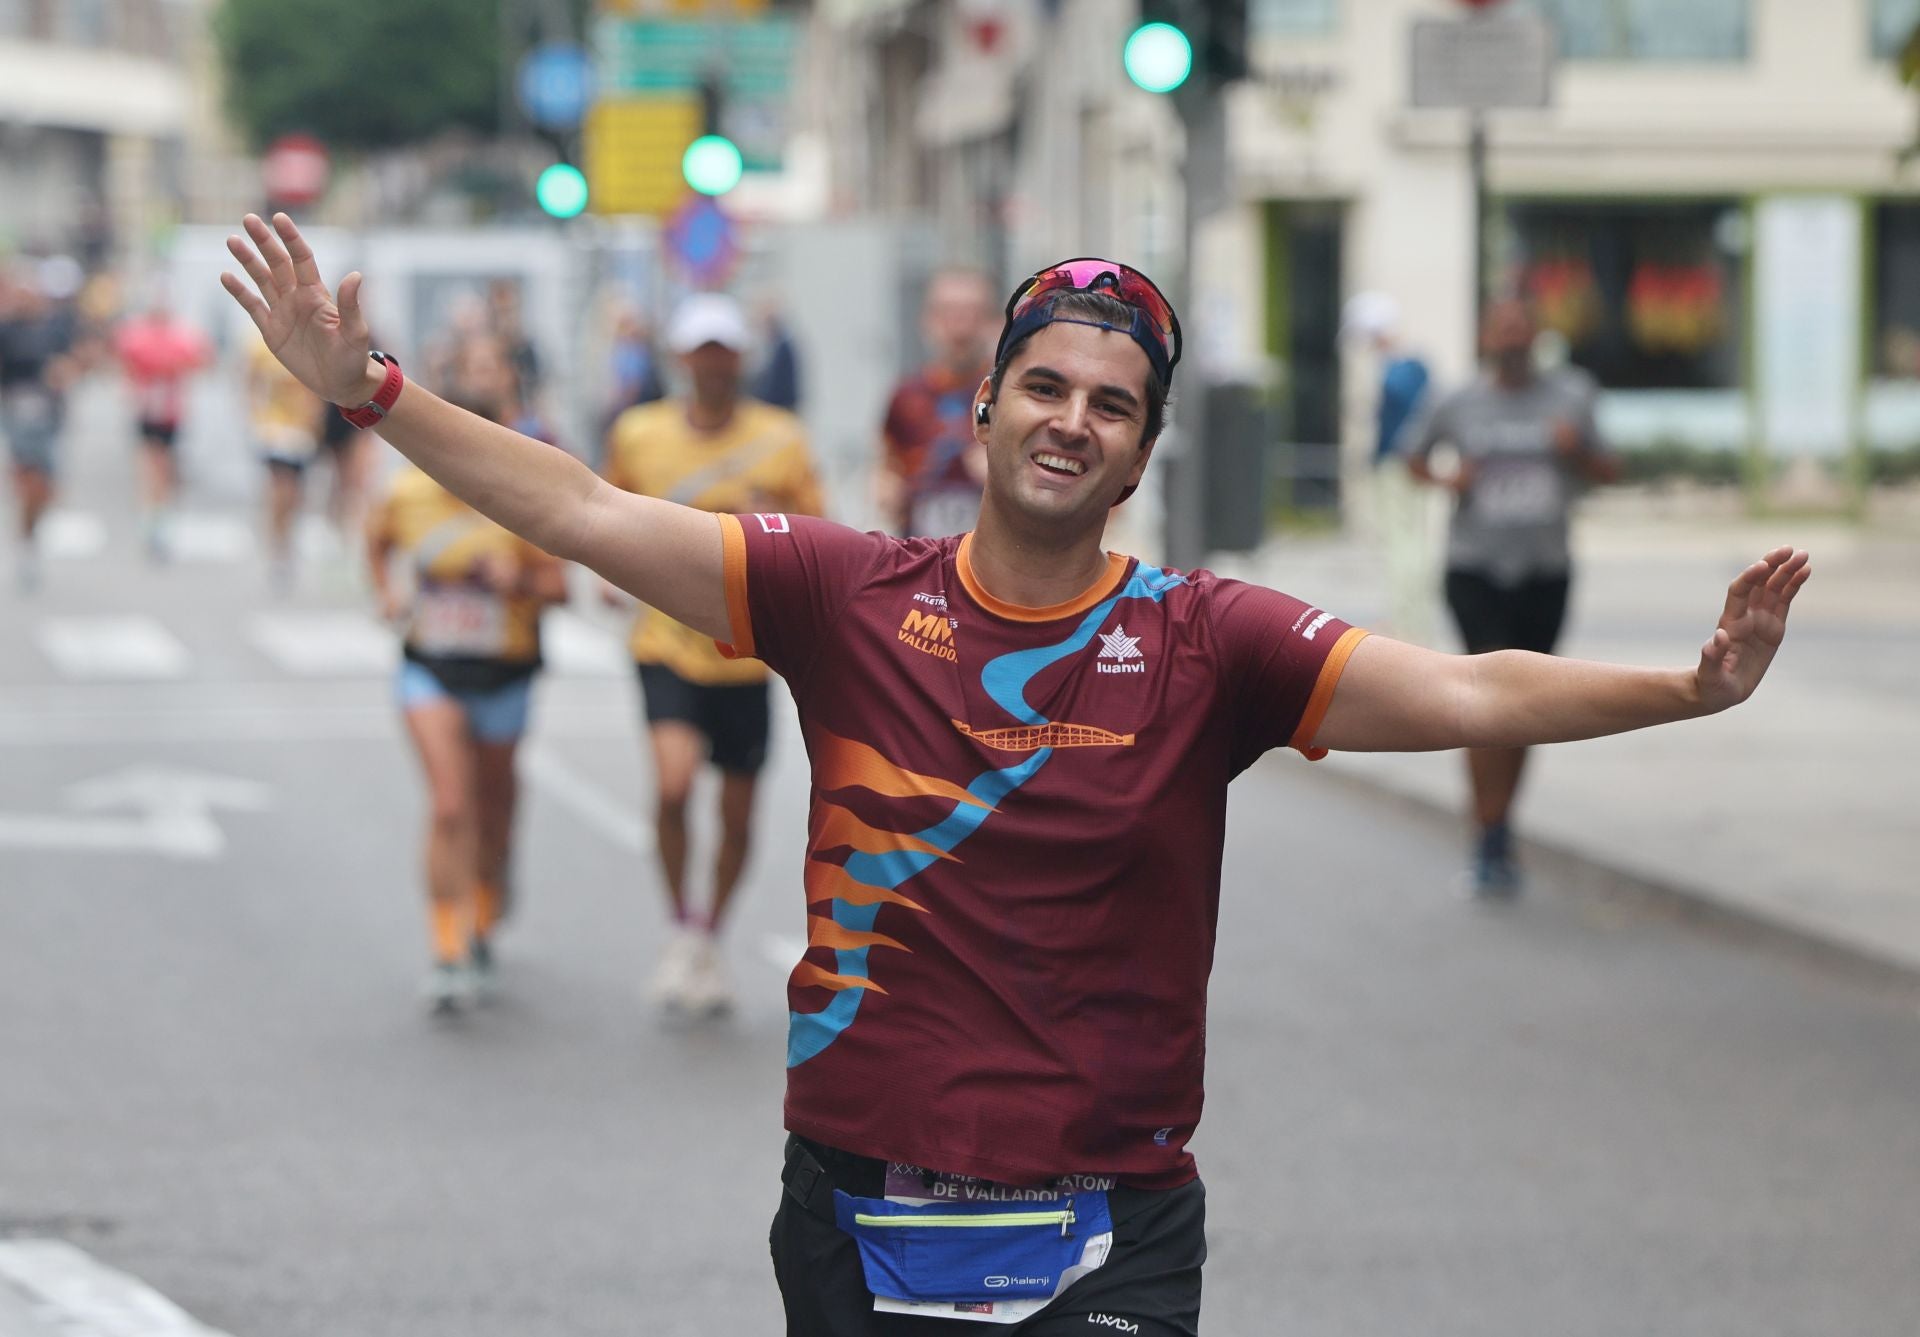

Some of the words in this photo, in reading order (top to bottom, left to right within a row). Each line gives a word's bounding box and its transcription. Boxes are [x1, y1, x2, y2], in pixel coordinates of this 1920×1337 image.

[898, 629, 958, 664] VALLADO
[1097, 660, 1145, 673] luanvi
[933, 1182, 959, 1198] DE
[1010, 1276, 1049, 1287] Kalenji
[1087, 1312, 1139, 1335] LIXADA
